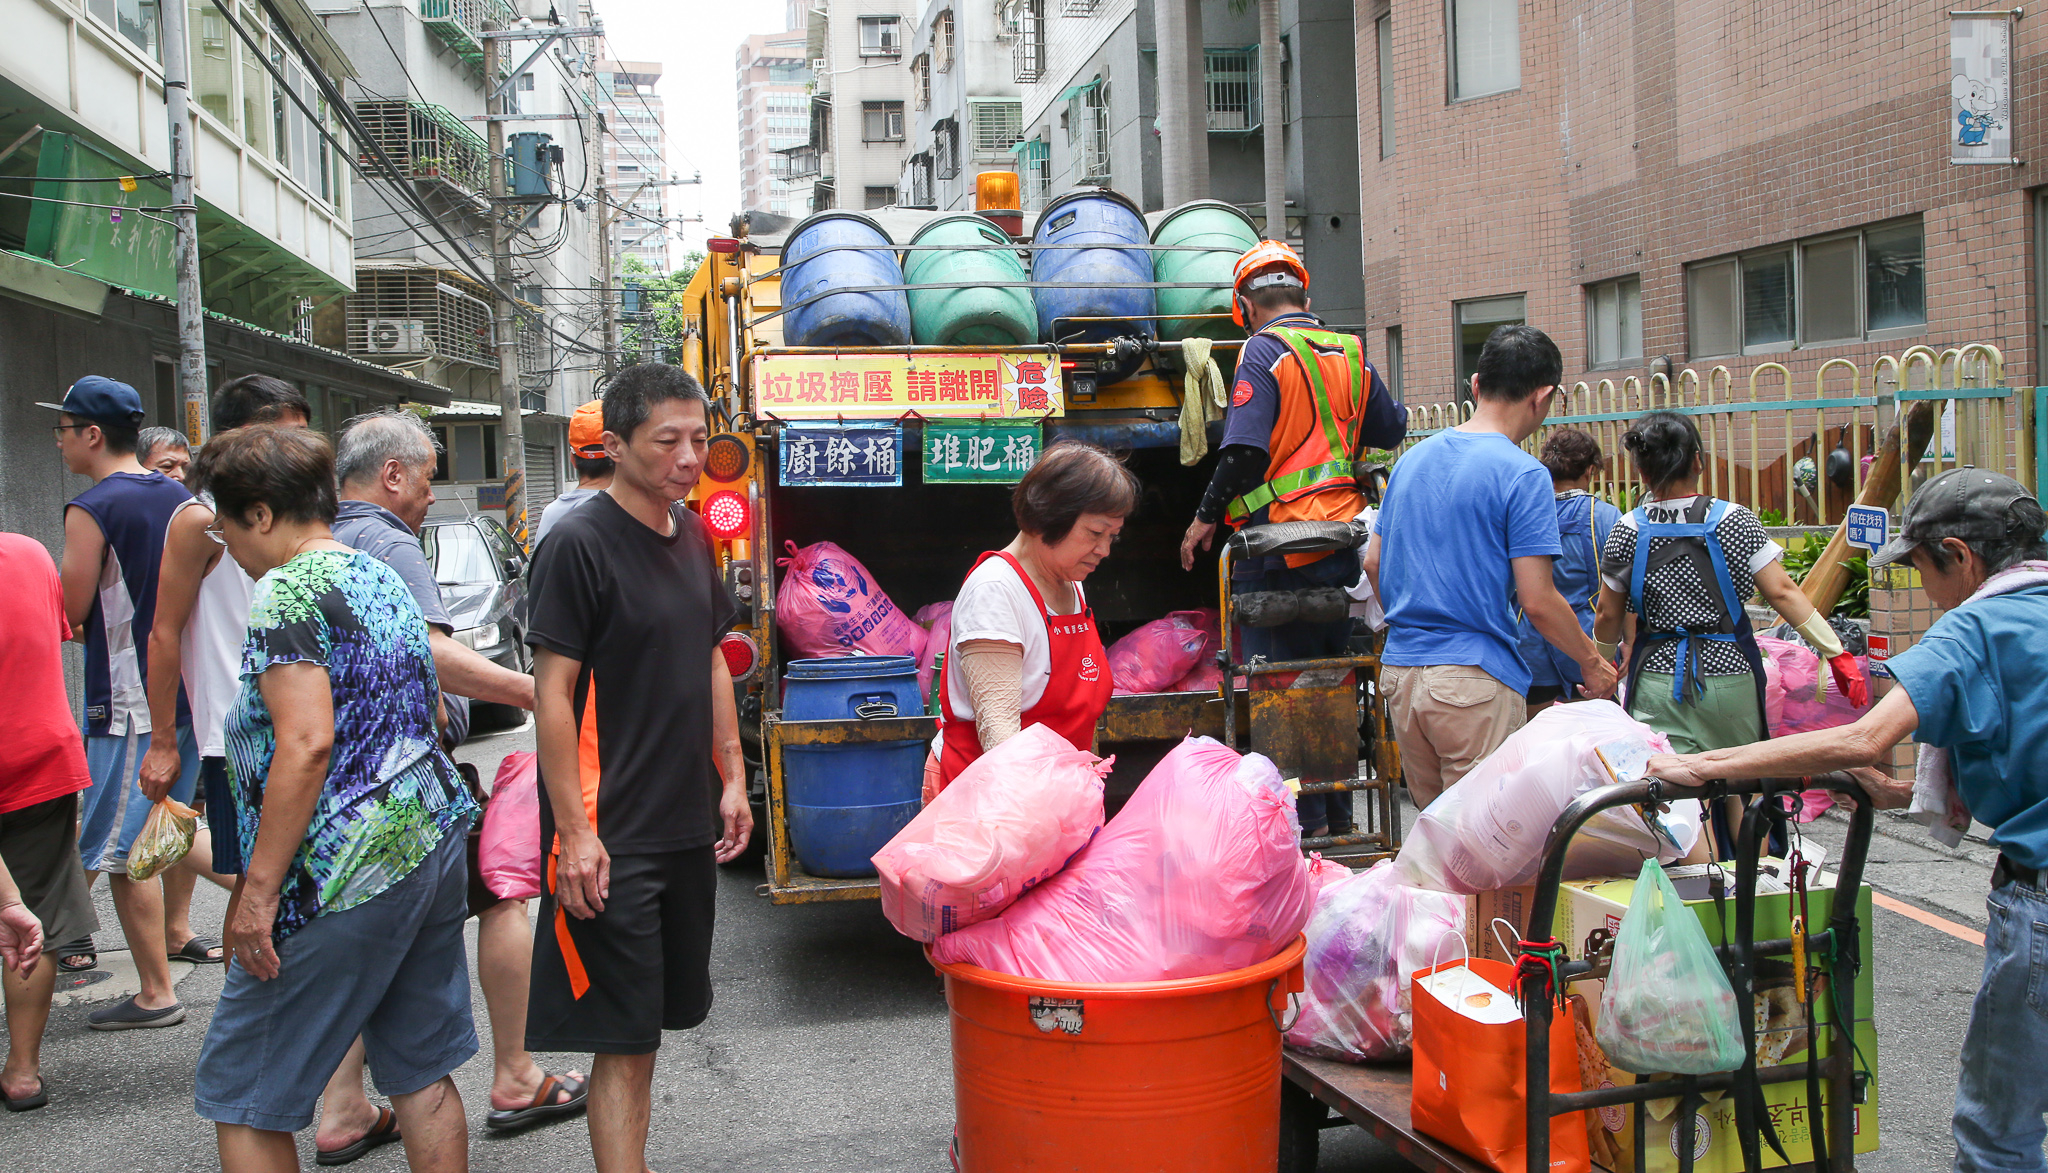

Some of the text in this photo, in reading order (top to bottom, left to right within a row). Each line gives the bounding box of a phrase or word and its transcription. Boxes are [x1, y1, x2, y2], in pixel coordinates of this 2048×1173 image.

[762, 370, 998, 402] 垃圾擠壓 請離開
[1016, 361, 1049, 410] 危險
[188, 403, 199, 444] 105441
[786, 435, 895, 476] 廚餘桶
[931, 432, 1035, 474] 堆肥桶
[1644, 506, 1679, 523] ADY
[1850, 512, 1883, 528] 你在找我
